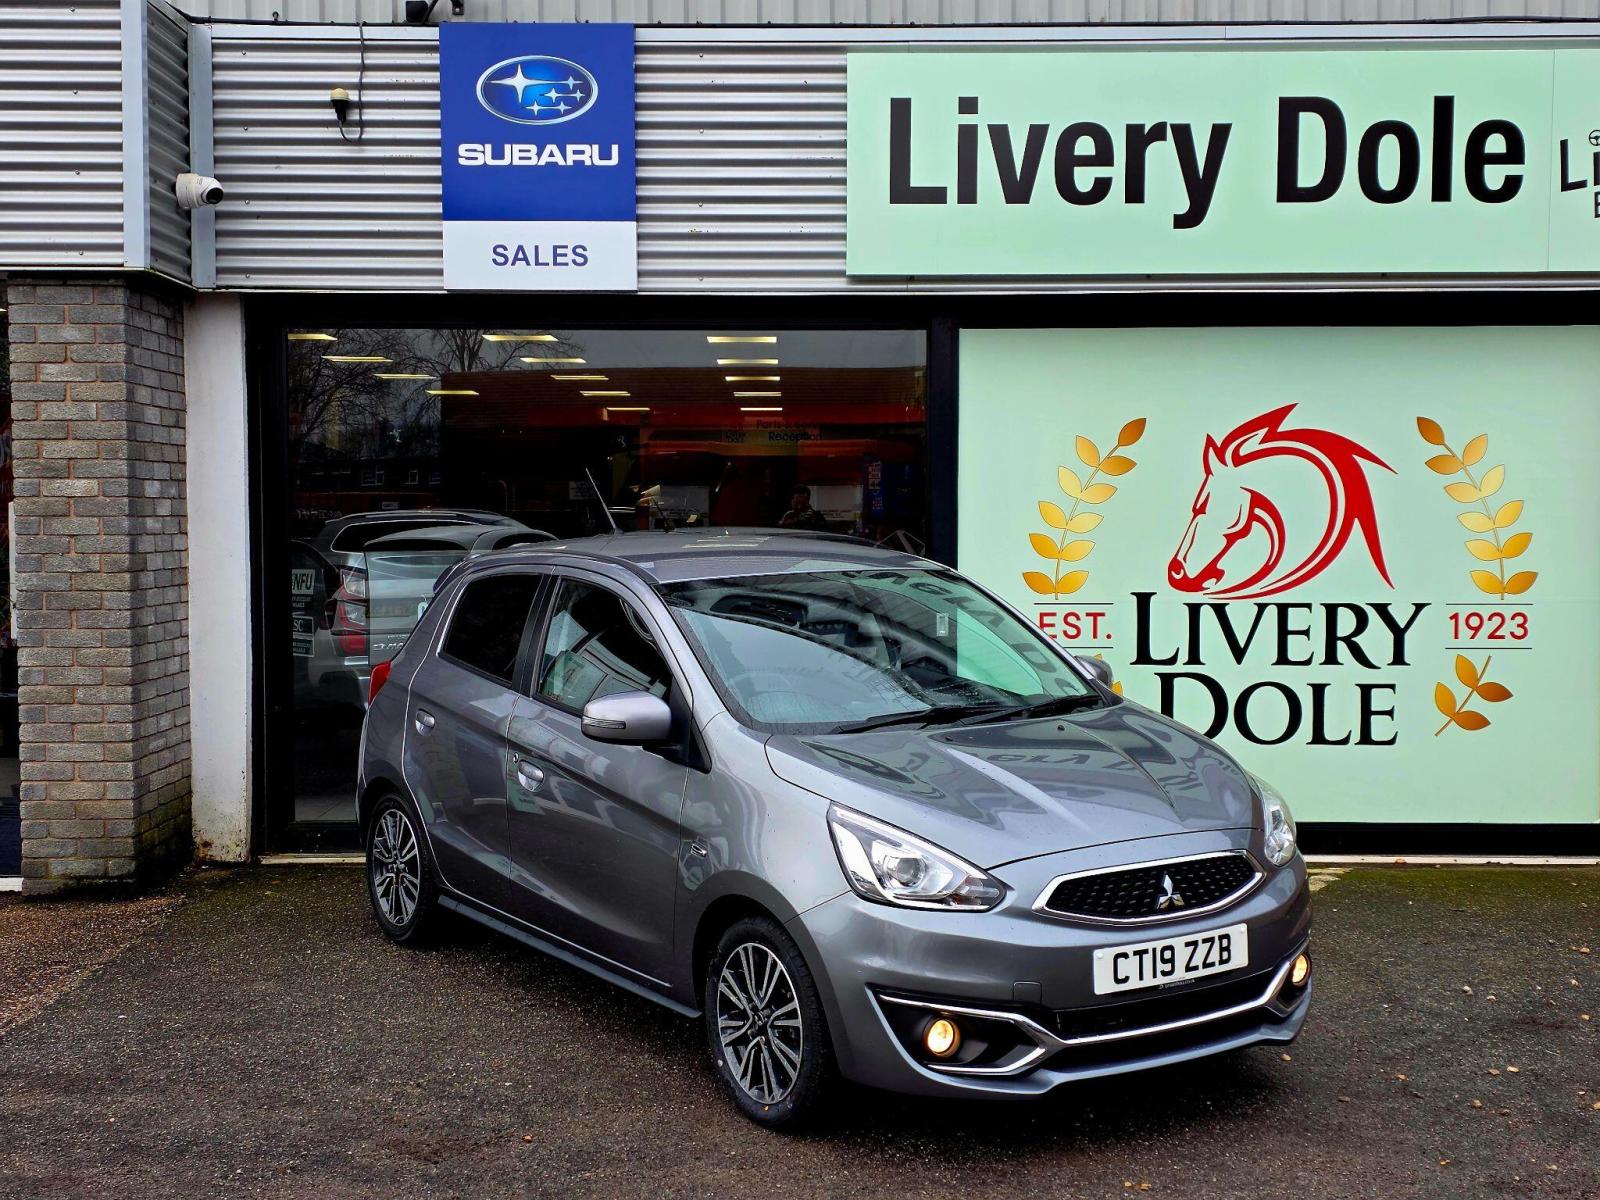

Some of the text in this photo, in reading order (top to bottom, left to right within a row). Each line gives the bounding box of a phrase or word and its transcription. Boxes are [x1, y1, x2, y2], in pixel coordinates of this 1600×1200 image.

[457, 143, 620, 168] SUBARU
[890, 96, 1525, 229] Livery Dole
[491, 244, 589, 267] SALES
[768, 432, 822, 442] Reception
[1039, 611, 1112, 640] EST.
[1129, 592, 1431, 670] LIVERY
[1449, 612, 1529, 640] 1923
[1153, 672, 1399, 747] DOLE
[1112, 933, 1232, 985] CT19 ZZB
